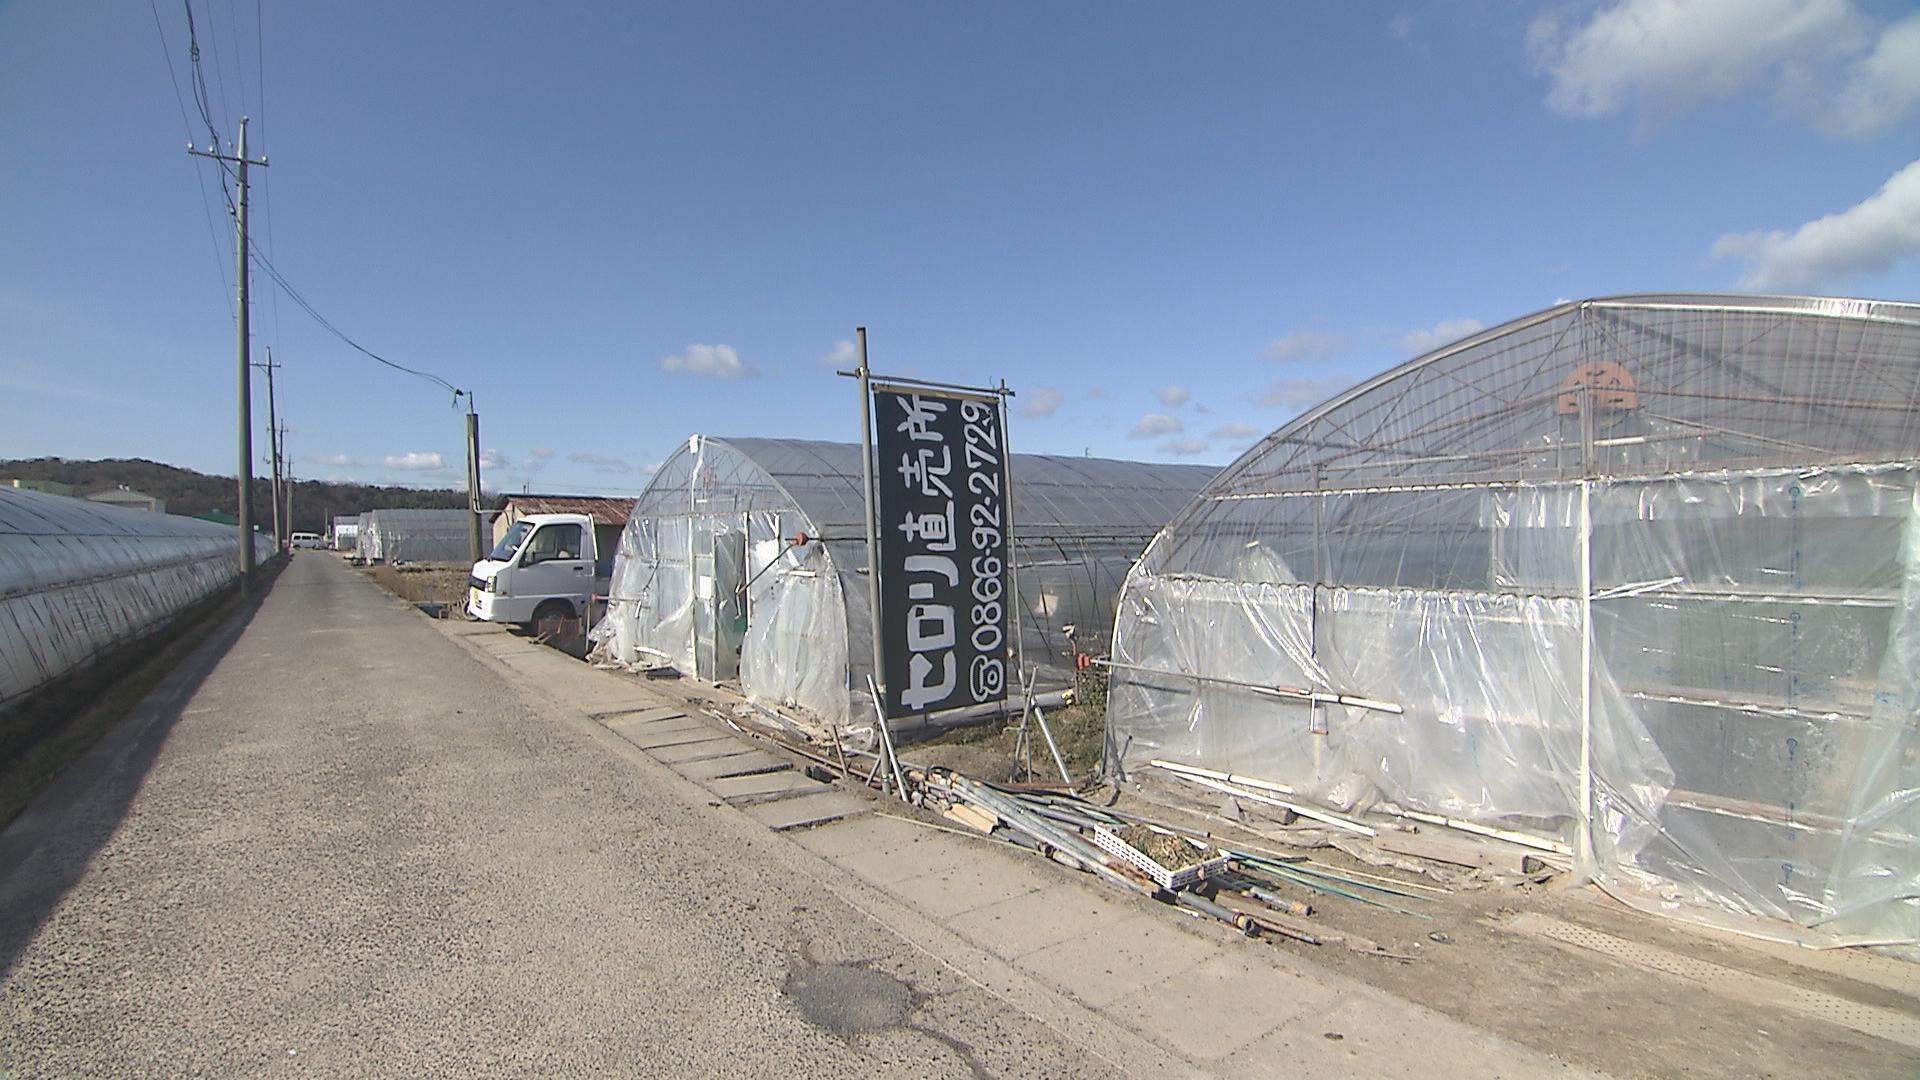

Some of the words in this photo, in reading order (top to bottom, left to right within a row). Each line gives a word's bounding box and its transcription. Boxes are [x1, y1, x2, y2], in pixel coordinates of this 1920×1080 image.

[897, 394, 960, 709] セロリ直売所
[961, 399, 1003, 651] 0866-92-2729
